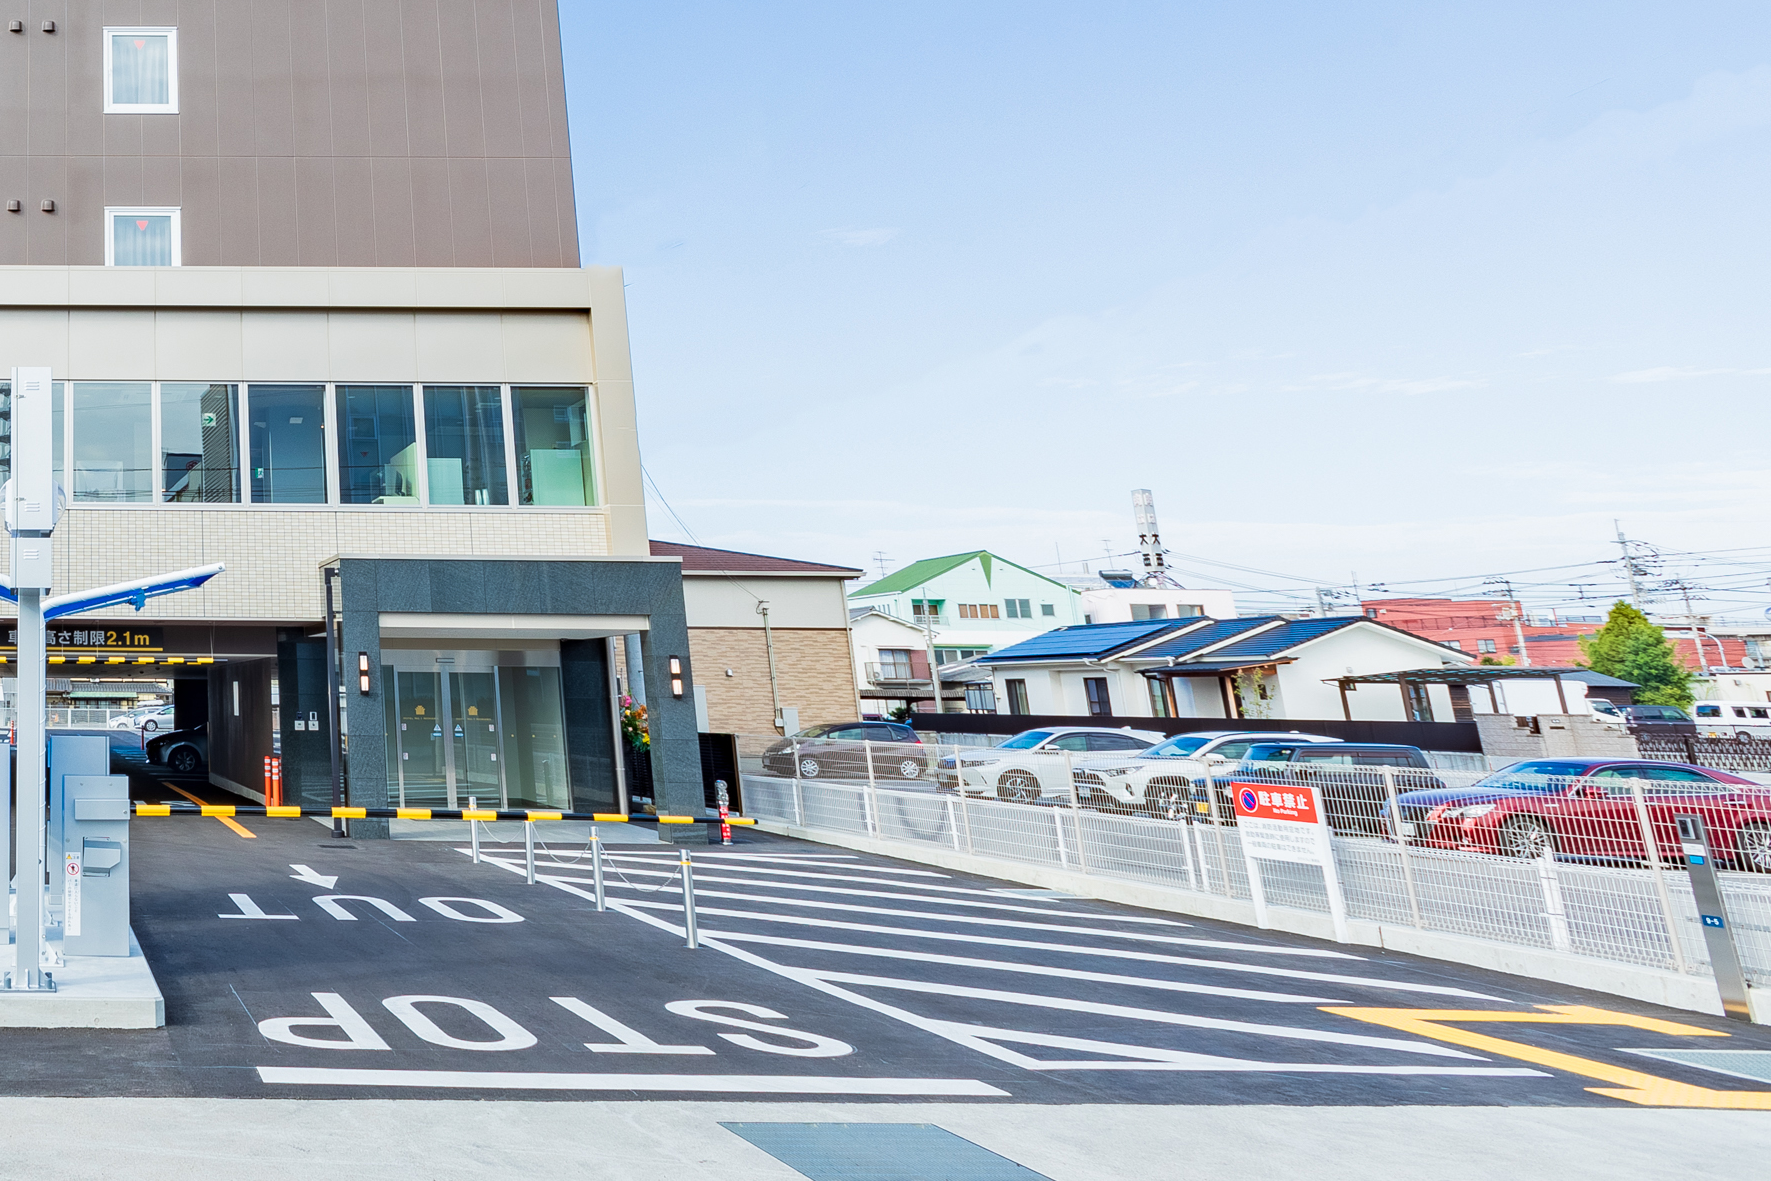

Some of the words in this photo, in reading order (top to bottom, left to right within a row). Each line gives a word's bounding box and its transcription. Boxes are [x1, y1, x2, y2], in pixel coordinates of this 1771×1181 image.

[1258, 791, 1309, 810] 駐車禁止
[1280, 808, 1298, 817] Parking
[218, 893, 526, 923] OUT
[257, 992, 857, 1058] STOP
